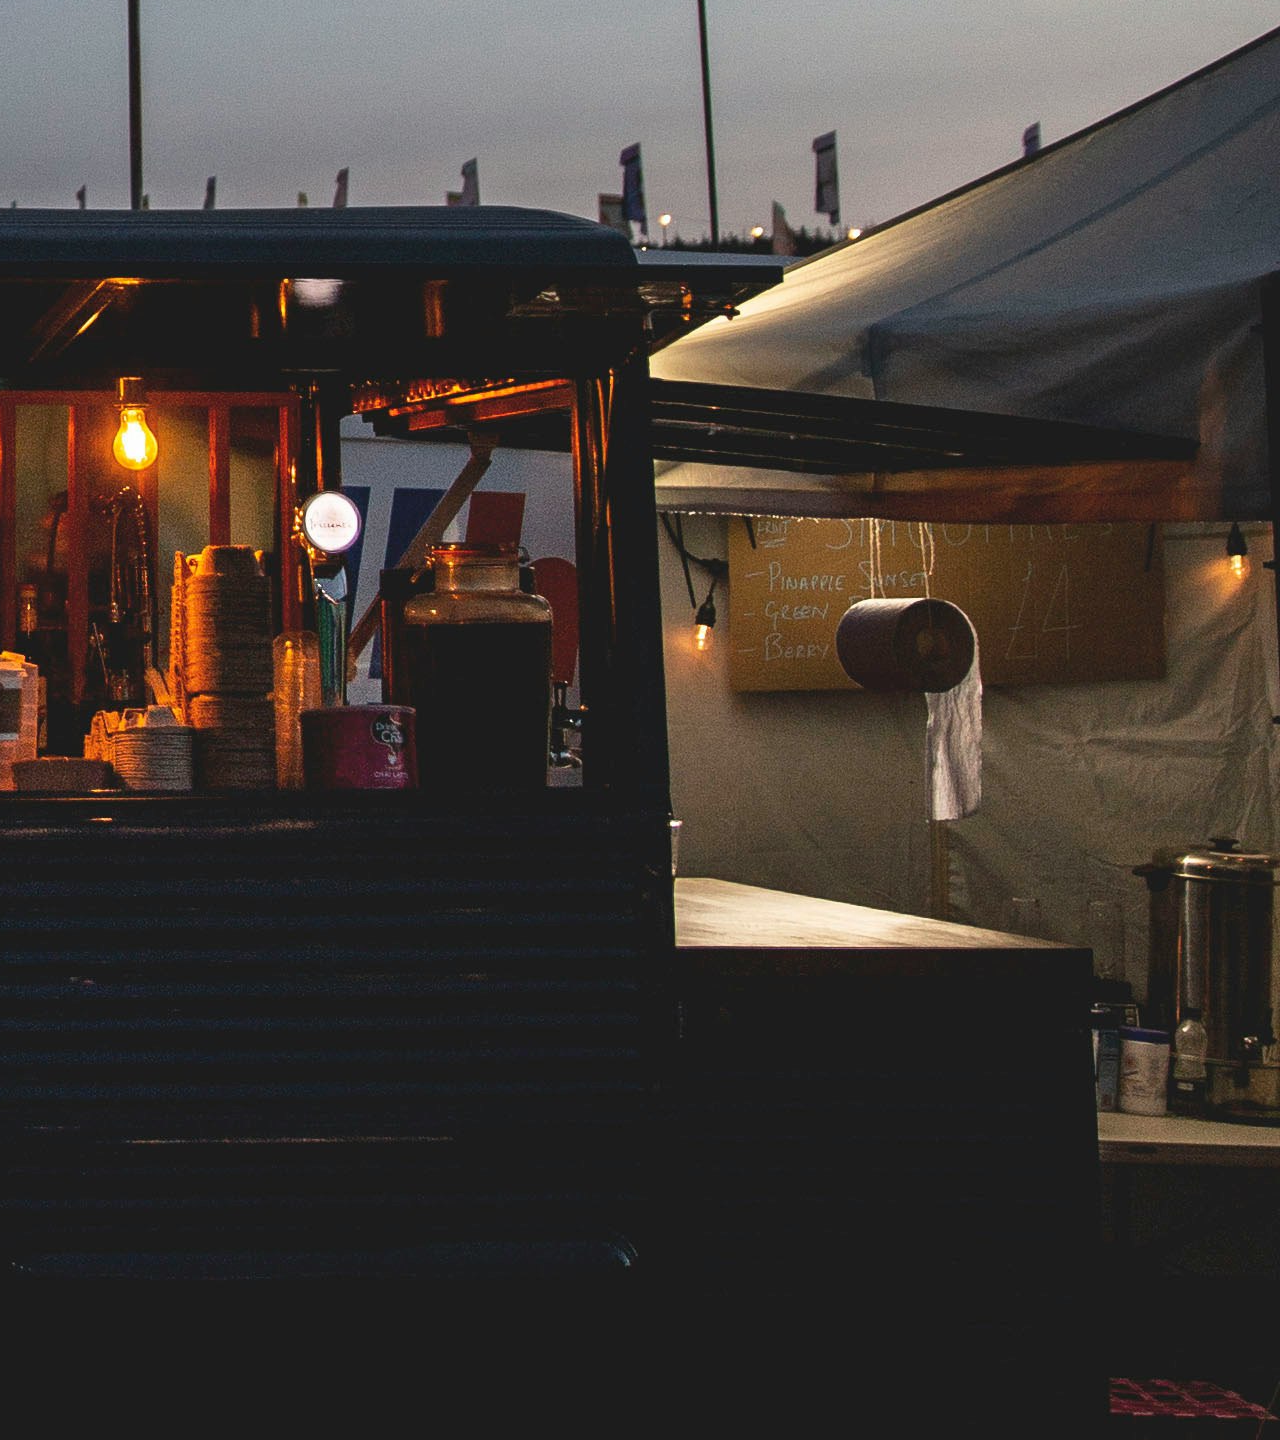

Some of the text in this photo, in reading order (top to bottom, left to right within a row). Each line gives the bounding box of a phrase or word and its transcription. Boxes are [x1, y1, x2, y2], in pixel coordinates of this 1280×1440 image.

[769, 561, 847, 592] PINAPPLE
[764, 600, 830, 631] GREEN
[764, 632, 830, 662] BERRY
